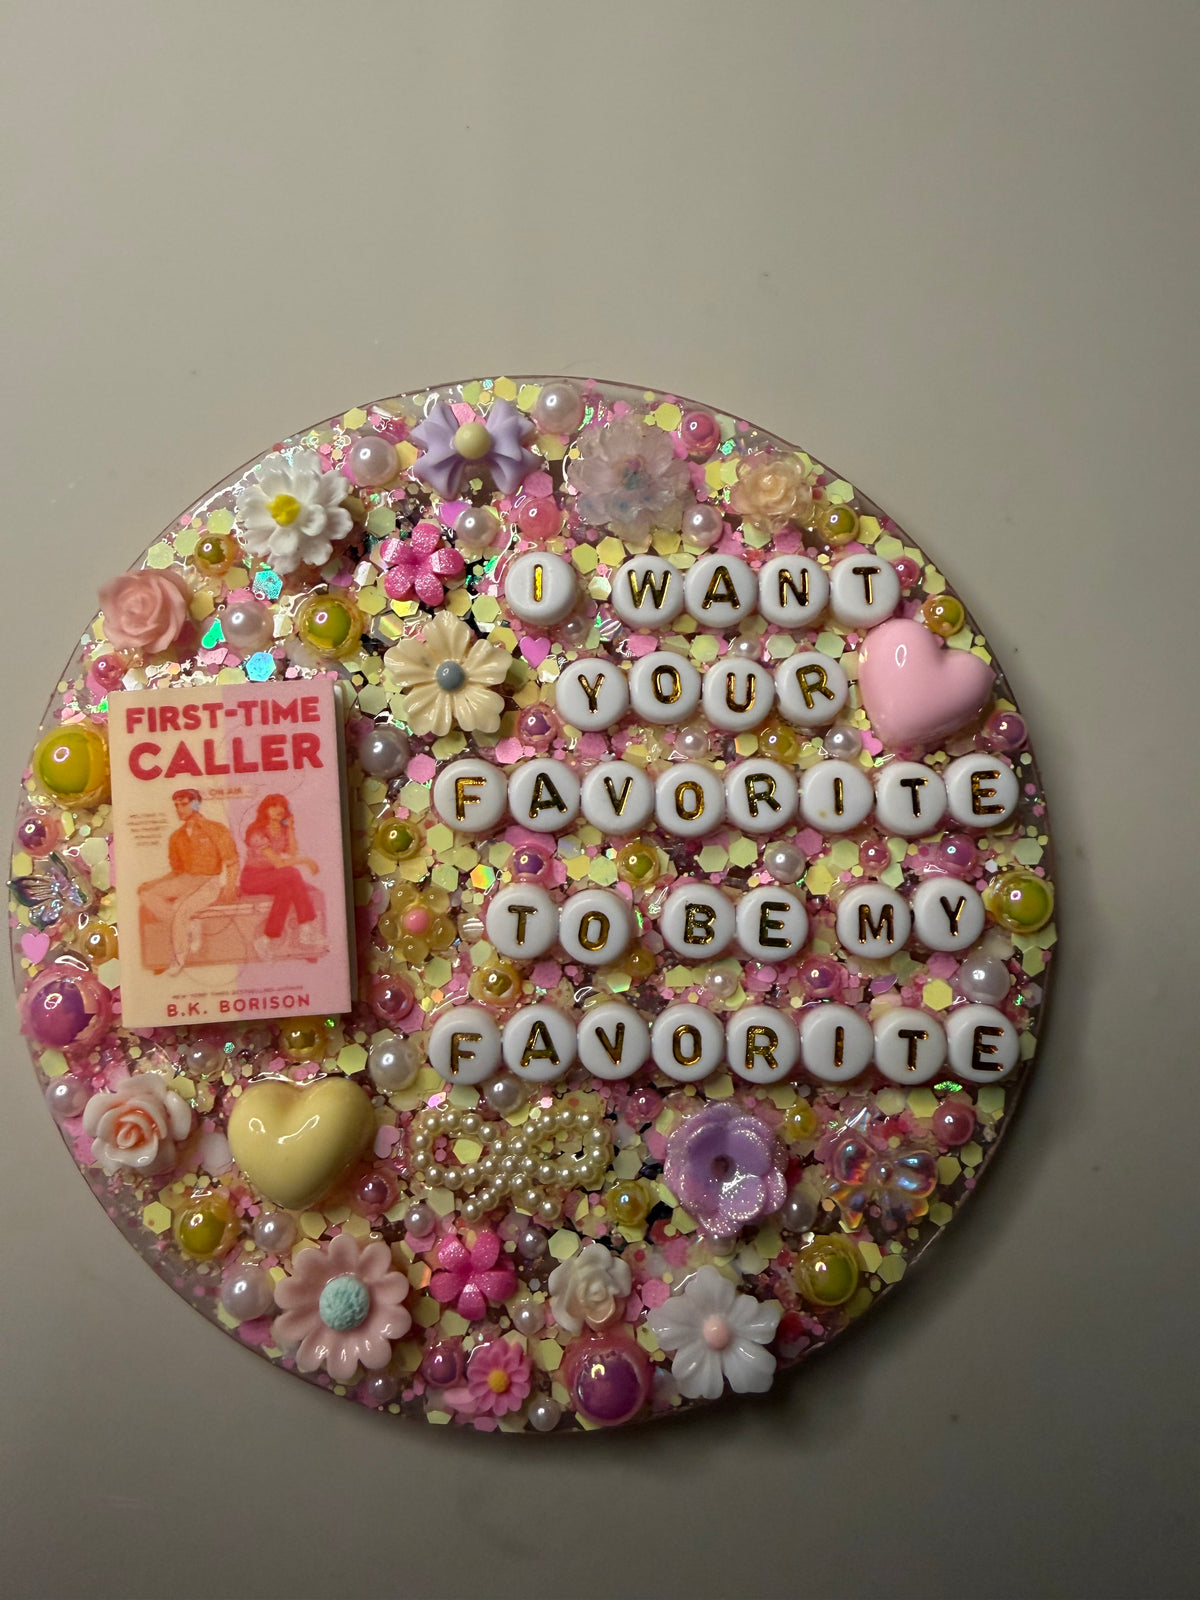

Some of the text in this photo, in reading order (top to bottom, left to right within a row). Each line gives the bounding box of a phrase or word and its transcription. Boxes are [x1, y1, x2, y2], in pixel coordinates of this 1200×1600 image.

[532, 564, 880, 610] I WANT
[578, 664, 836, 713] YOUR
[126, 696, 321, 734] FIRST-TIME
[128, 732, 324, 781] CALLER
[455, 769, 1006, 821] FAVORITE
[507, 895, 966, 951] TO BE MY
[166, 994, 310, 1017] B.K. BORISON
[450, 1020, 1005, 1074] FAVORITE
